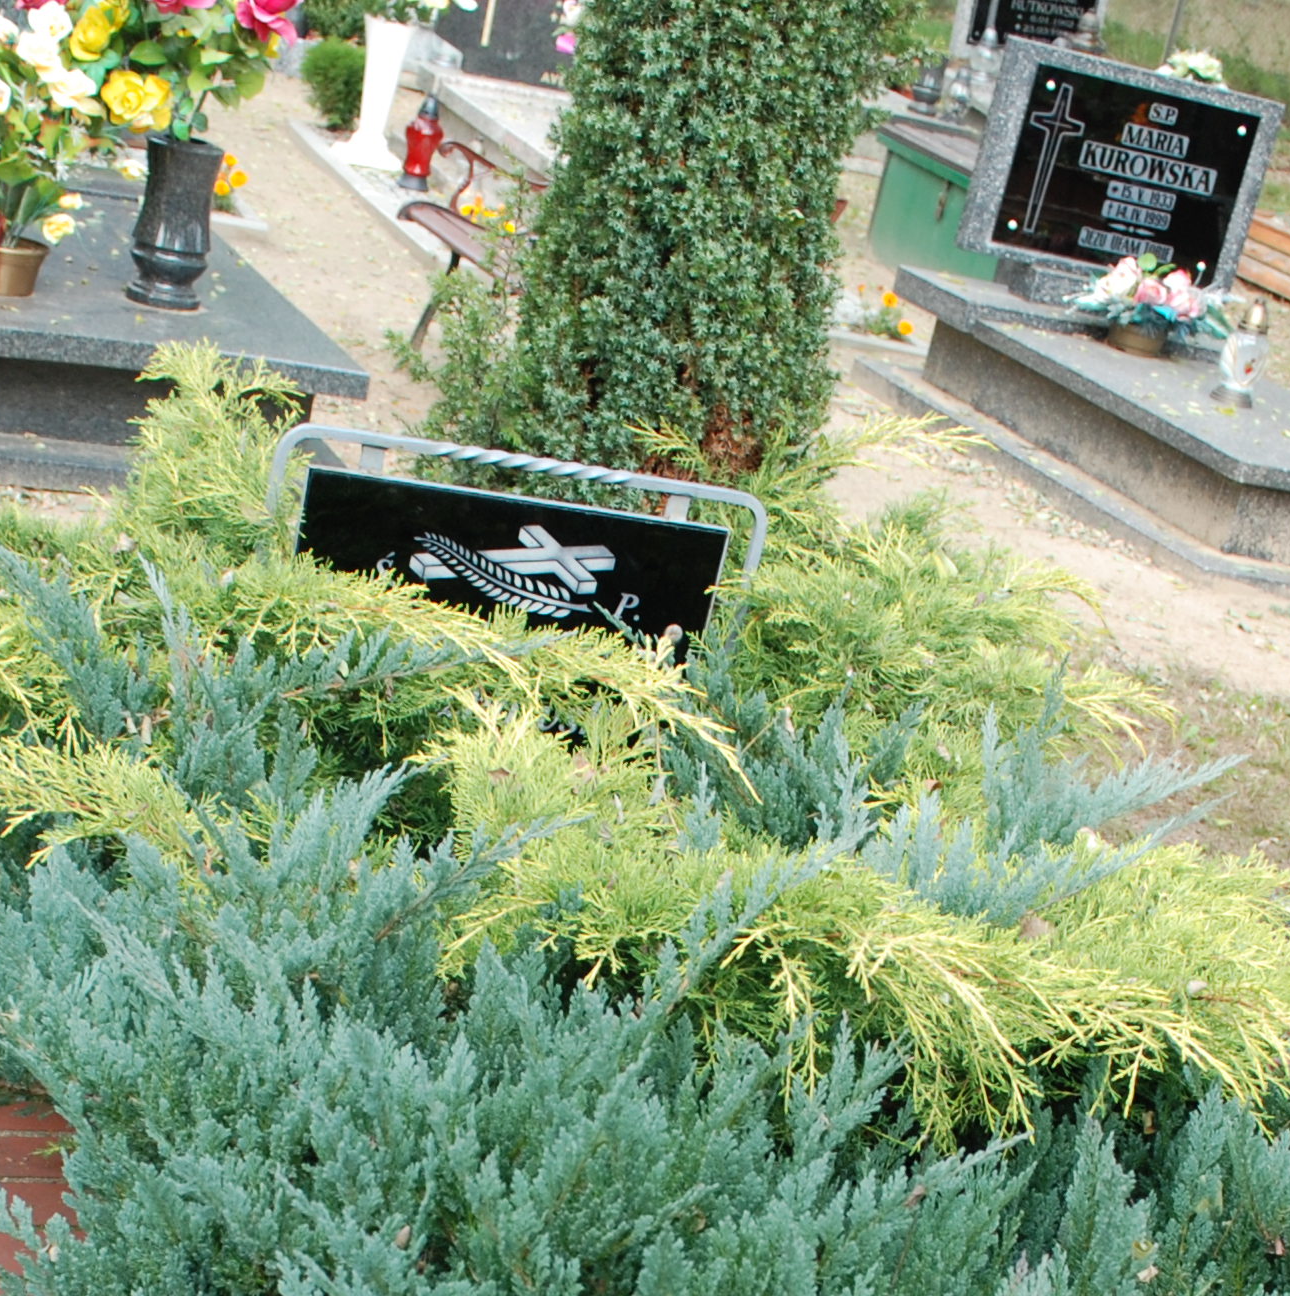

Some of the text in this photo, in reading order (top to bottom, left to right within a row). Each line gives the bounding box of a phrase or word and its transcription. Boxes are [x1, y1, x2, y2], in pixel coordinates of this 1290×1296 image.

[1123, 125, 1185, 157] MARIA
[1081, 143, 1212, 193] KUROWSKA
[1149, 191, 1175, 209] 1933
[1144, 211, 1170, 227] 1999
[1081, 228, 1108, 247] JEZU
[1110, 234, 1142, 255] UFAM
[614, 592, 641, 622] P.
